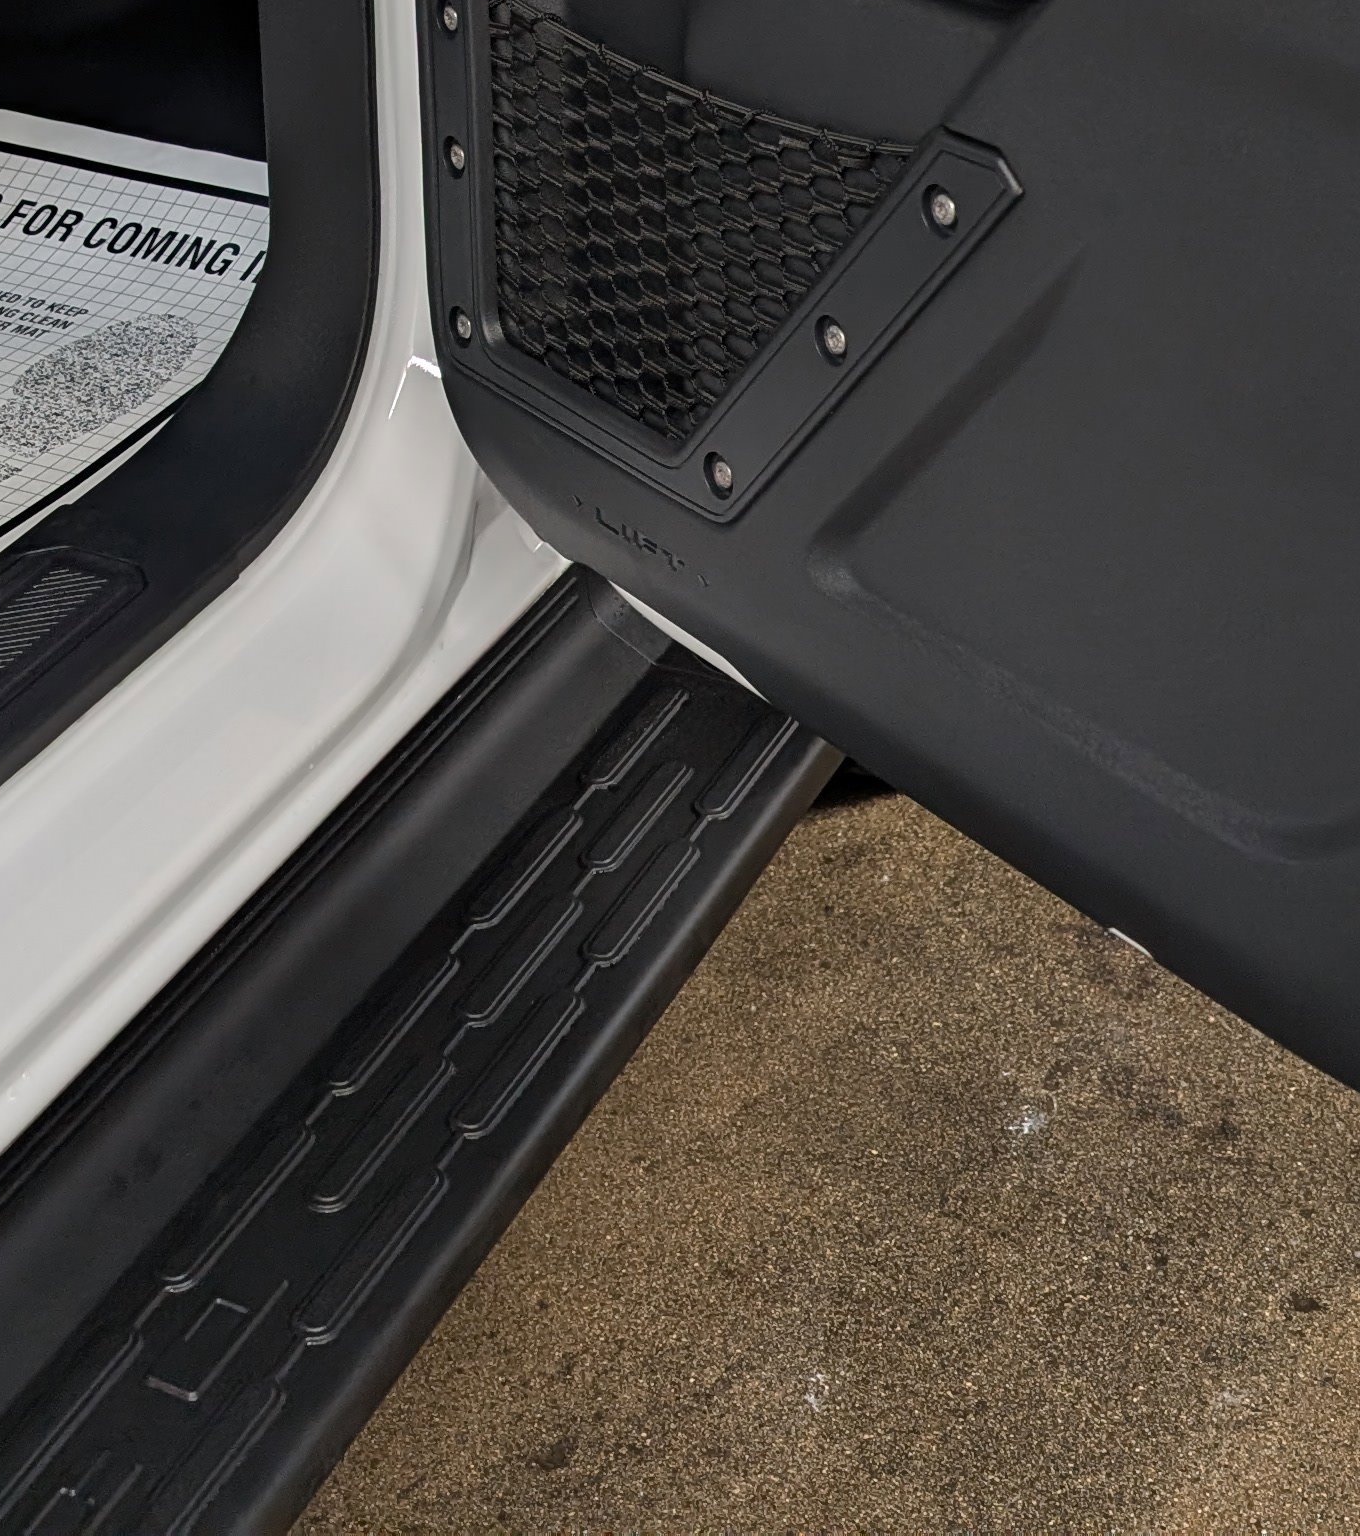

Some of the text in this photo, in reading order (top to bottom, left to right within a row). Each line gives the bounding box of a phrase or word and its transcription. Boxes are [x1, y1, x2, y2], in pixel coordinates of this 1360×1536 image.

[0, 200, 84, 242] FOR
[82, 217, 241, 277] COMING
[239, 250, 267, 283] I
[22, 297, 45, 310] TO
[44, 302, 90, 318] KEEP
[19, 312, 74, 330] CLEAN
[10, 325, 50, 340] MAT
